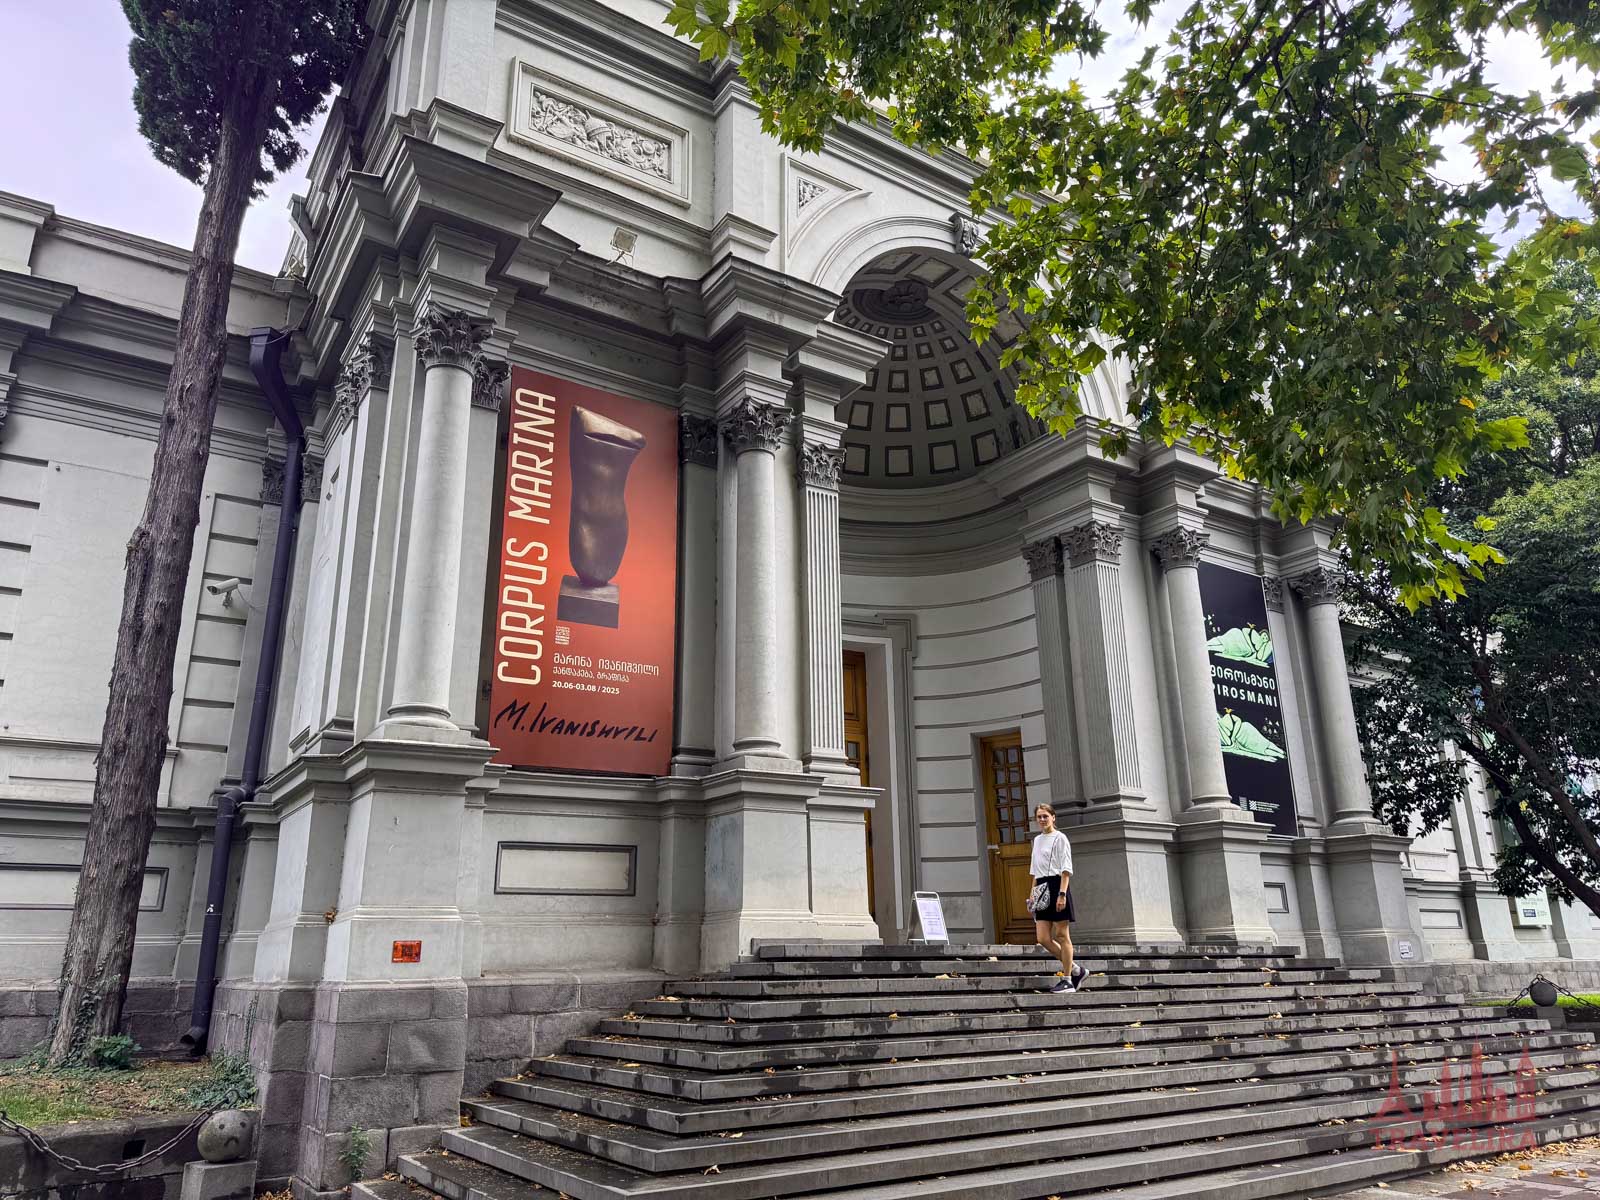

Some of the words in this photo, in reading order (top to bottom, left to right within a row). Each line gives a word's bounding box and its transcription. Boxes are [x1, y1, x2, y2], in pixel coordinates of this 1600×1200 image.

[508, 387, 556, 524] MARINA
[497, 537, 548, 685] CORPUS
[552, 681, 597, 692] 20.06-03.08
[554, 653, 592, 667] მარინა
[598, 659, 659, 676] ივანიშვილი
